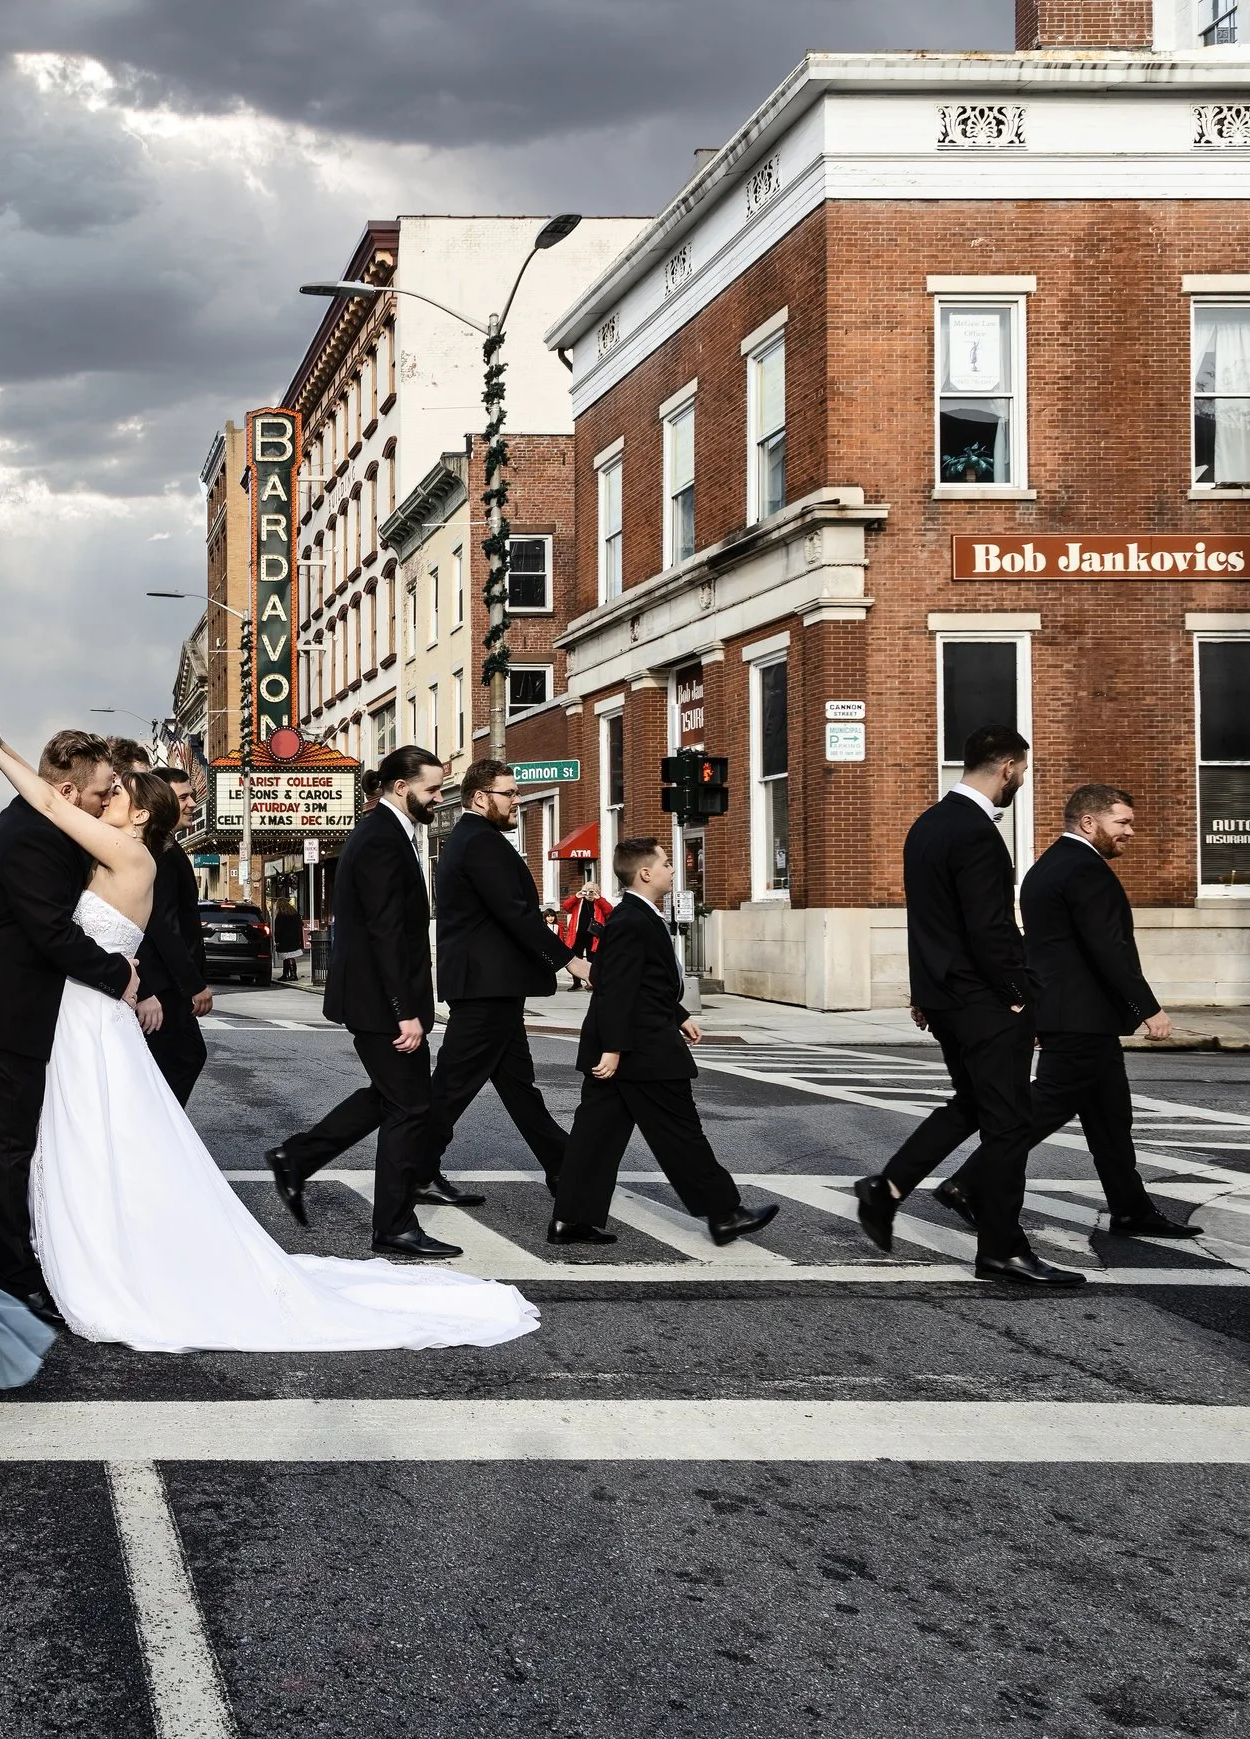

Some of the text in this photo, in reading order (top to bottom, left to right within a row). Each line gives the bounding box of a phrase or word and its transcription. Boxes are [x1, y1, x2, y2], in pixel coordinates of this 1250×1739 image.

[972, 541, 1246, 573] Bob Jankovics
[255, 417, 293, 742] BARDAVON
[677, 682, 691, 705] Bob
[681, 706, 705, 733] SUR
[513, 766, 558, 780] Cannon
[286, 777, 333, 787] COLLEGE
[229, 789, 343, 800] LESONS & CAROLS
[250, 802, 301, 813] ATURDAY
[301, 815, 322, 825] DEC
[325, 815, 354, 825] 16/17
[570, 849, 591, 858] ATM
